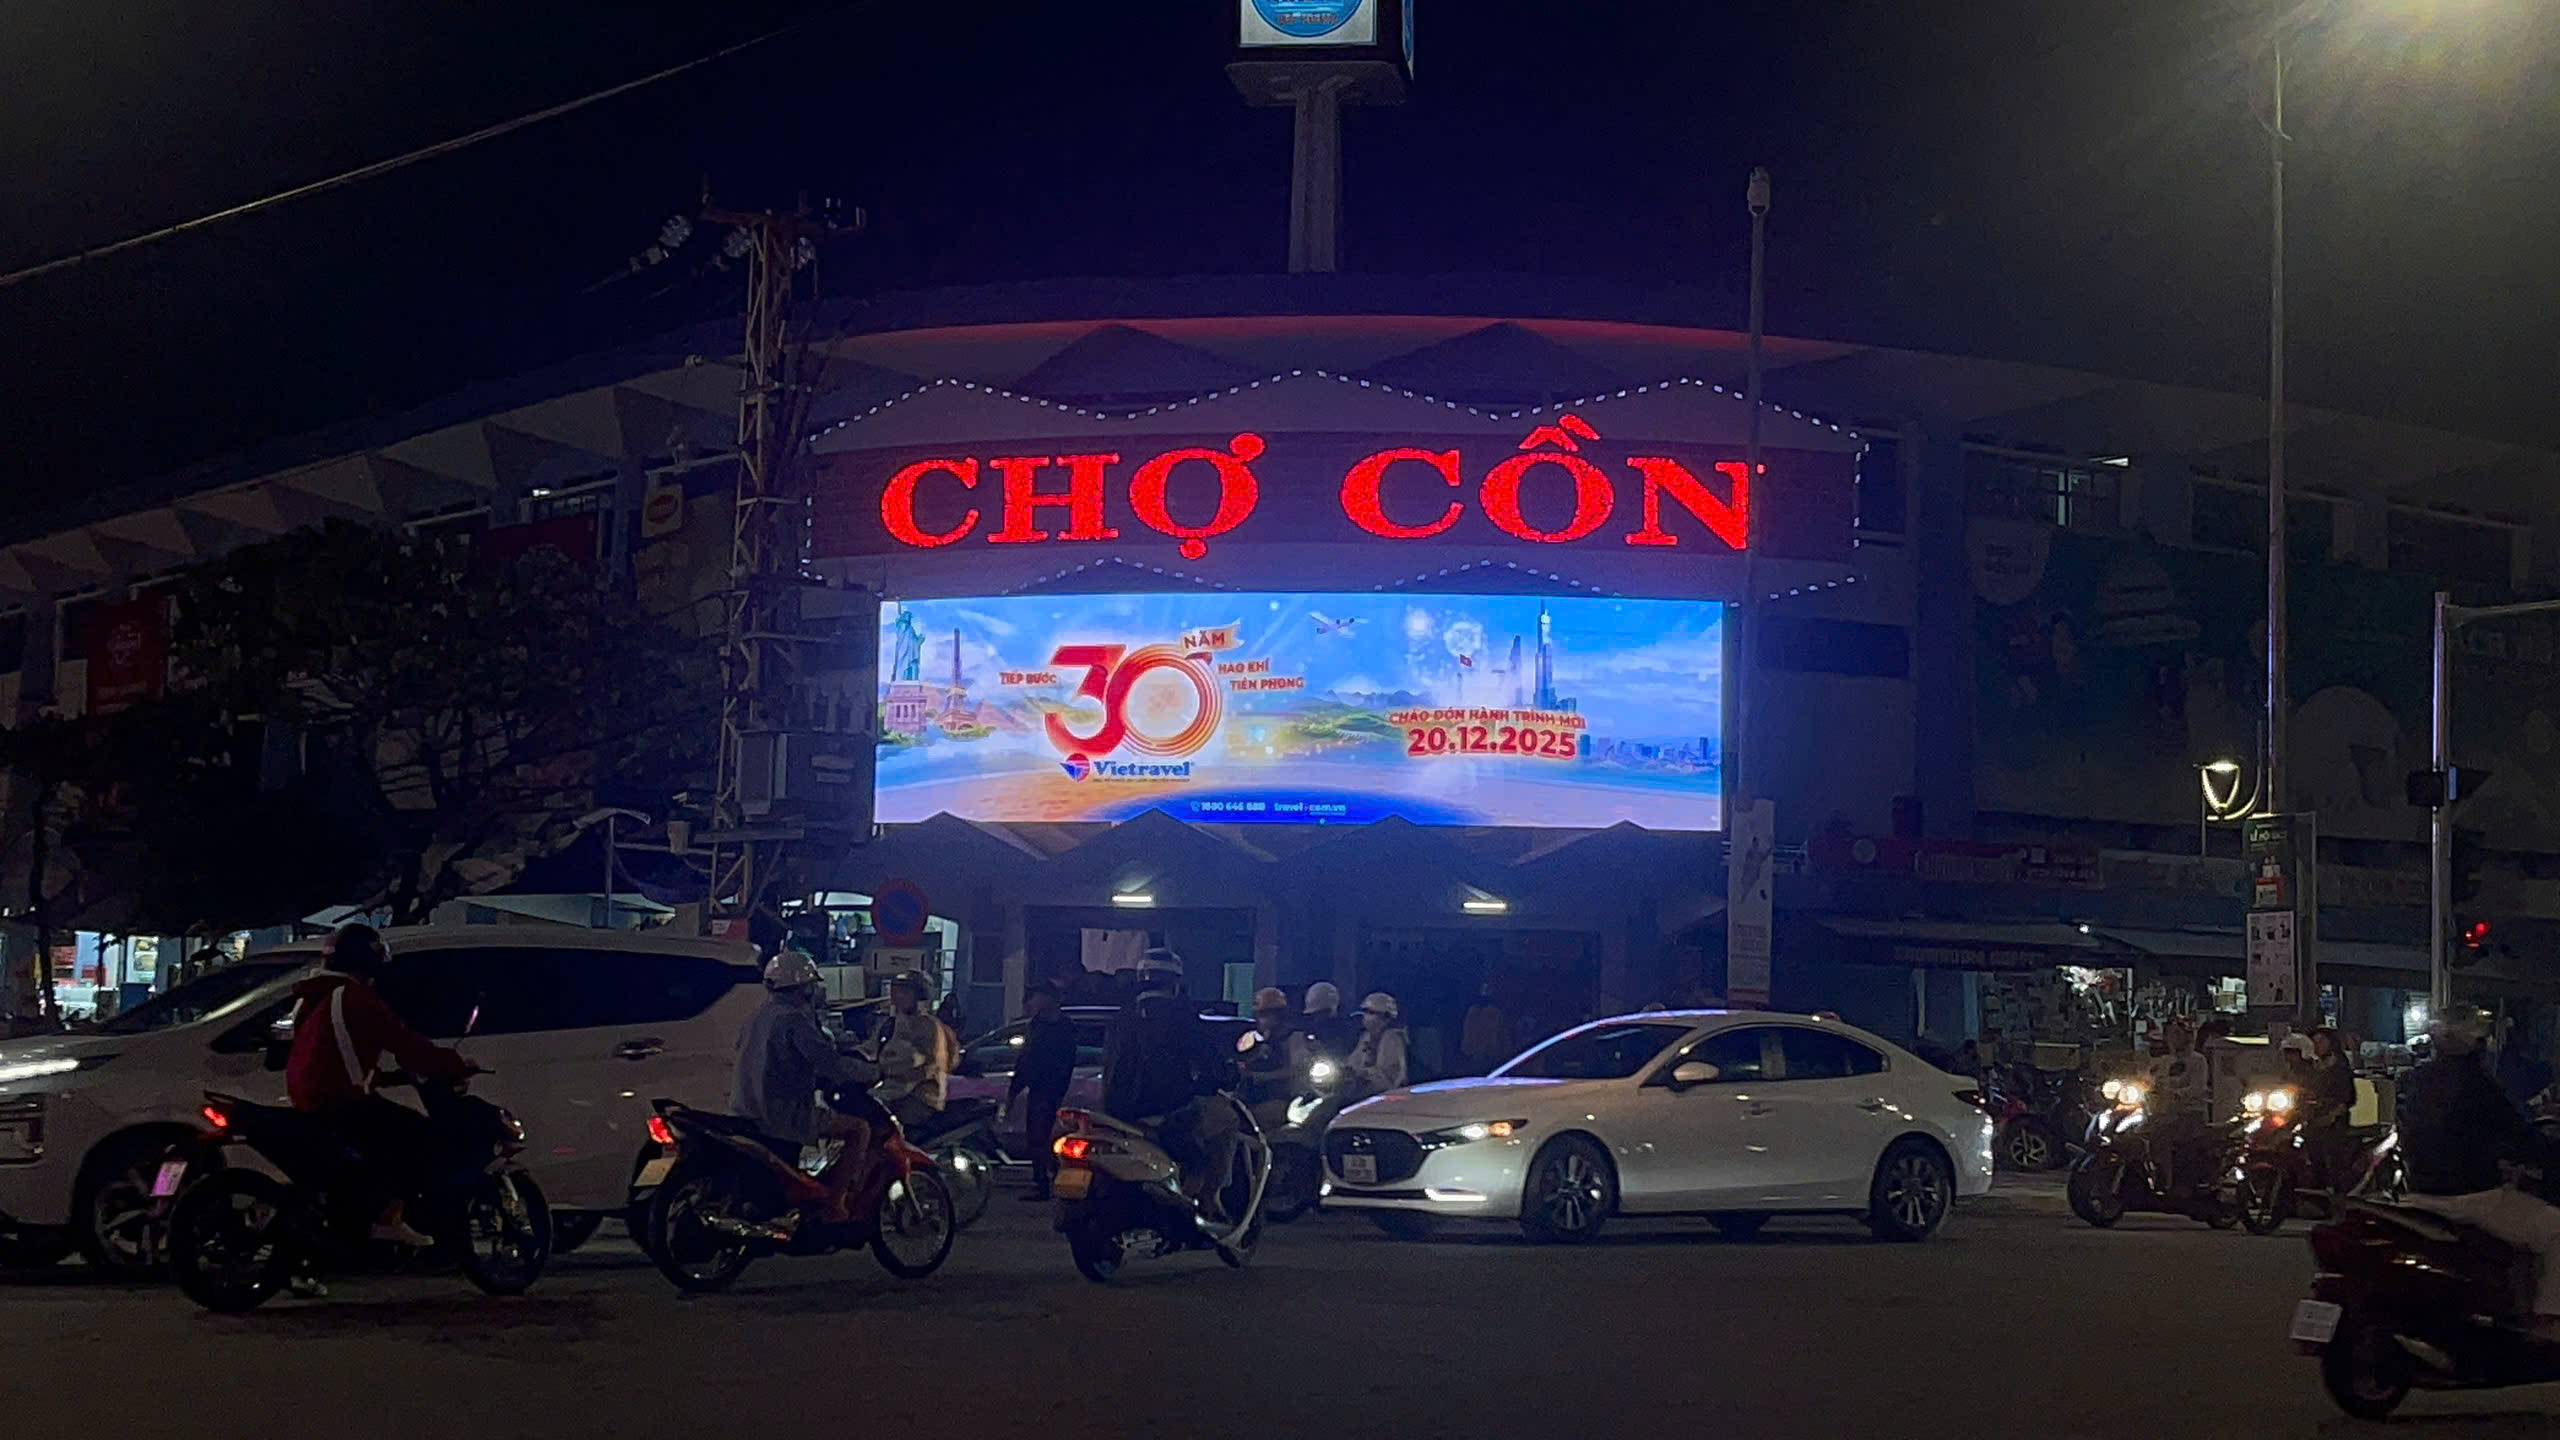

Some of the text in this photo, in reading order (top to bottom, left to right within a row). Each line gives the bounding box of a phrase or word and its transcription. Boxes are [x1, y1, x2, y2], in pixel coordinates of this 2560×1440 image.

[881, 413, 1767, 560] CHỢ CỒN
[1183, 630, 1225, 649] NĂM
[1260, 677, 1305, 689] PHONG
[1045, 644, 1222, 757] 30
[1408, 726, 1576, 757] 20.12.2025
[1093, 761, 1191, 776] Vietravel
